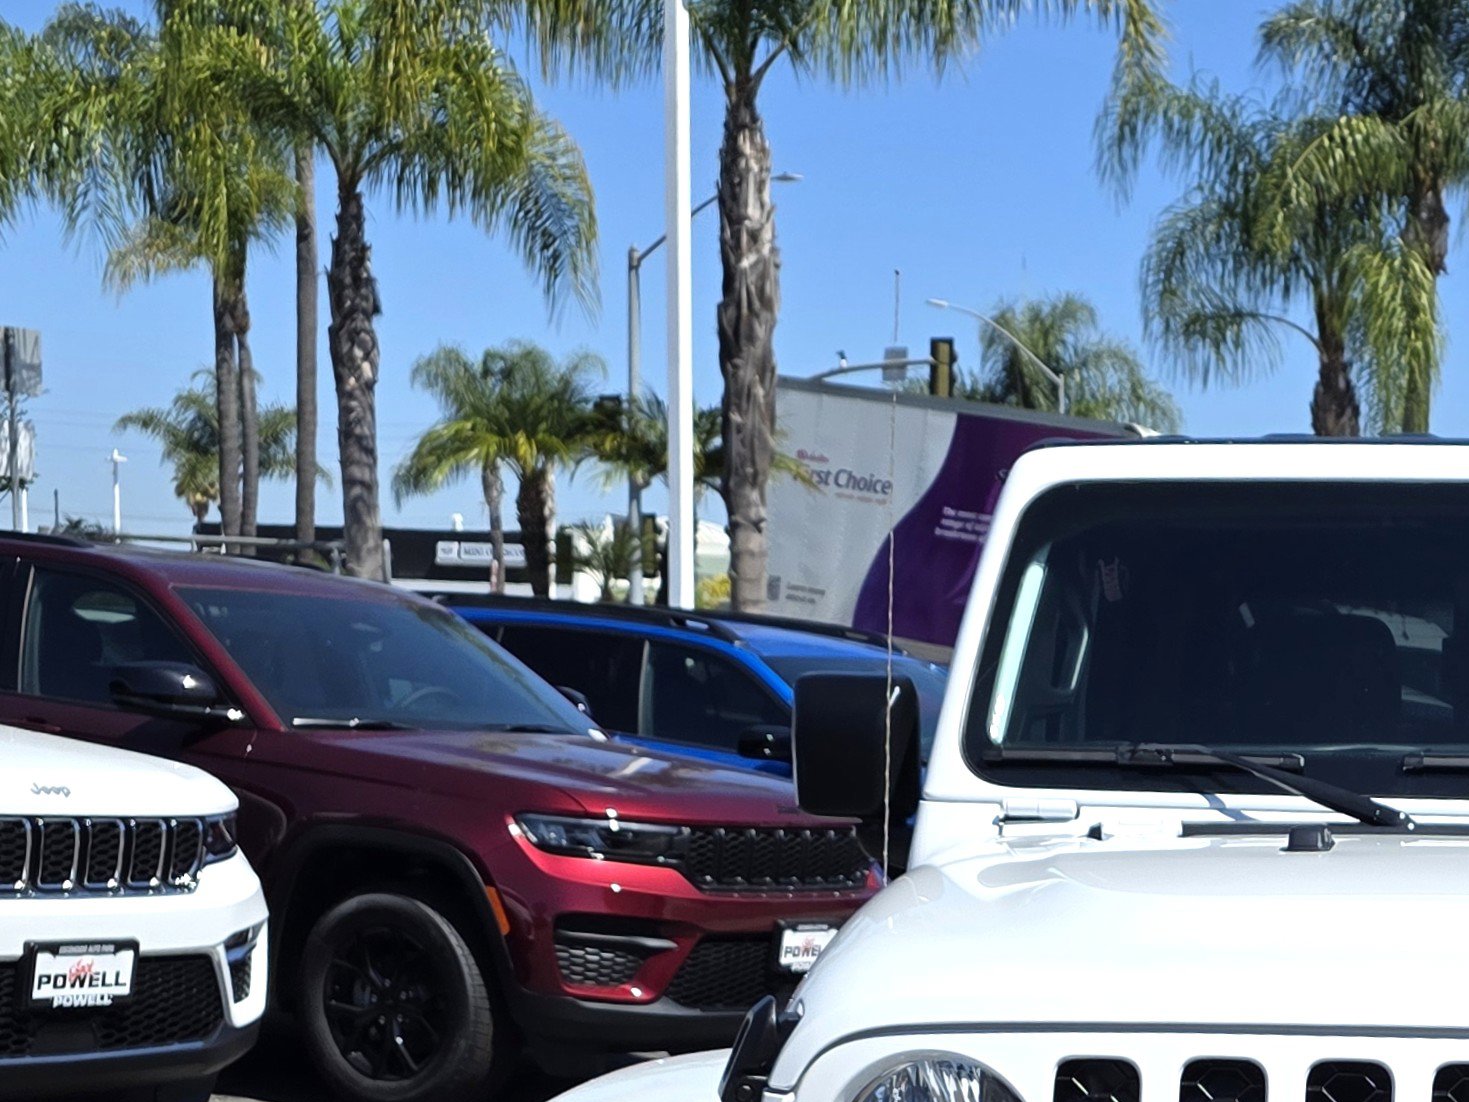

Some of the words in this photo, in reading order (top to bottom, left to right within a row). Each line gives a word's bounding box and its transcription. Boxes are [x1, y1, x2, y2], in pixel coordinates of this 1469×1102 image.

[834, 468, 893, 495] Choice
[37, 971, 127, 991] POWELL
[52, 993, 114, 1009] POWELL
